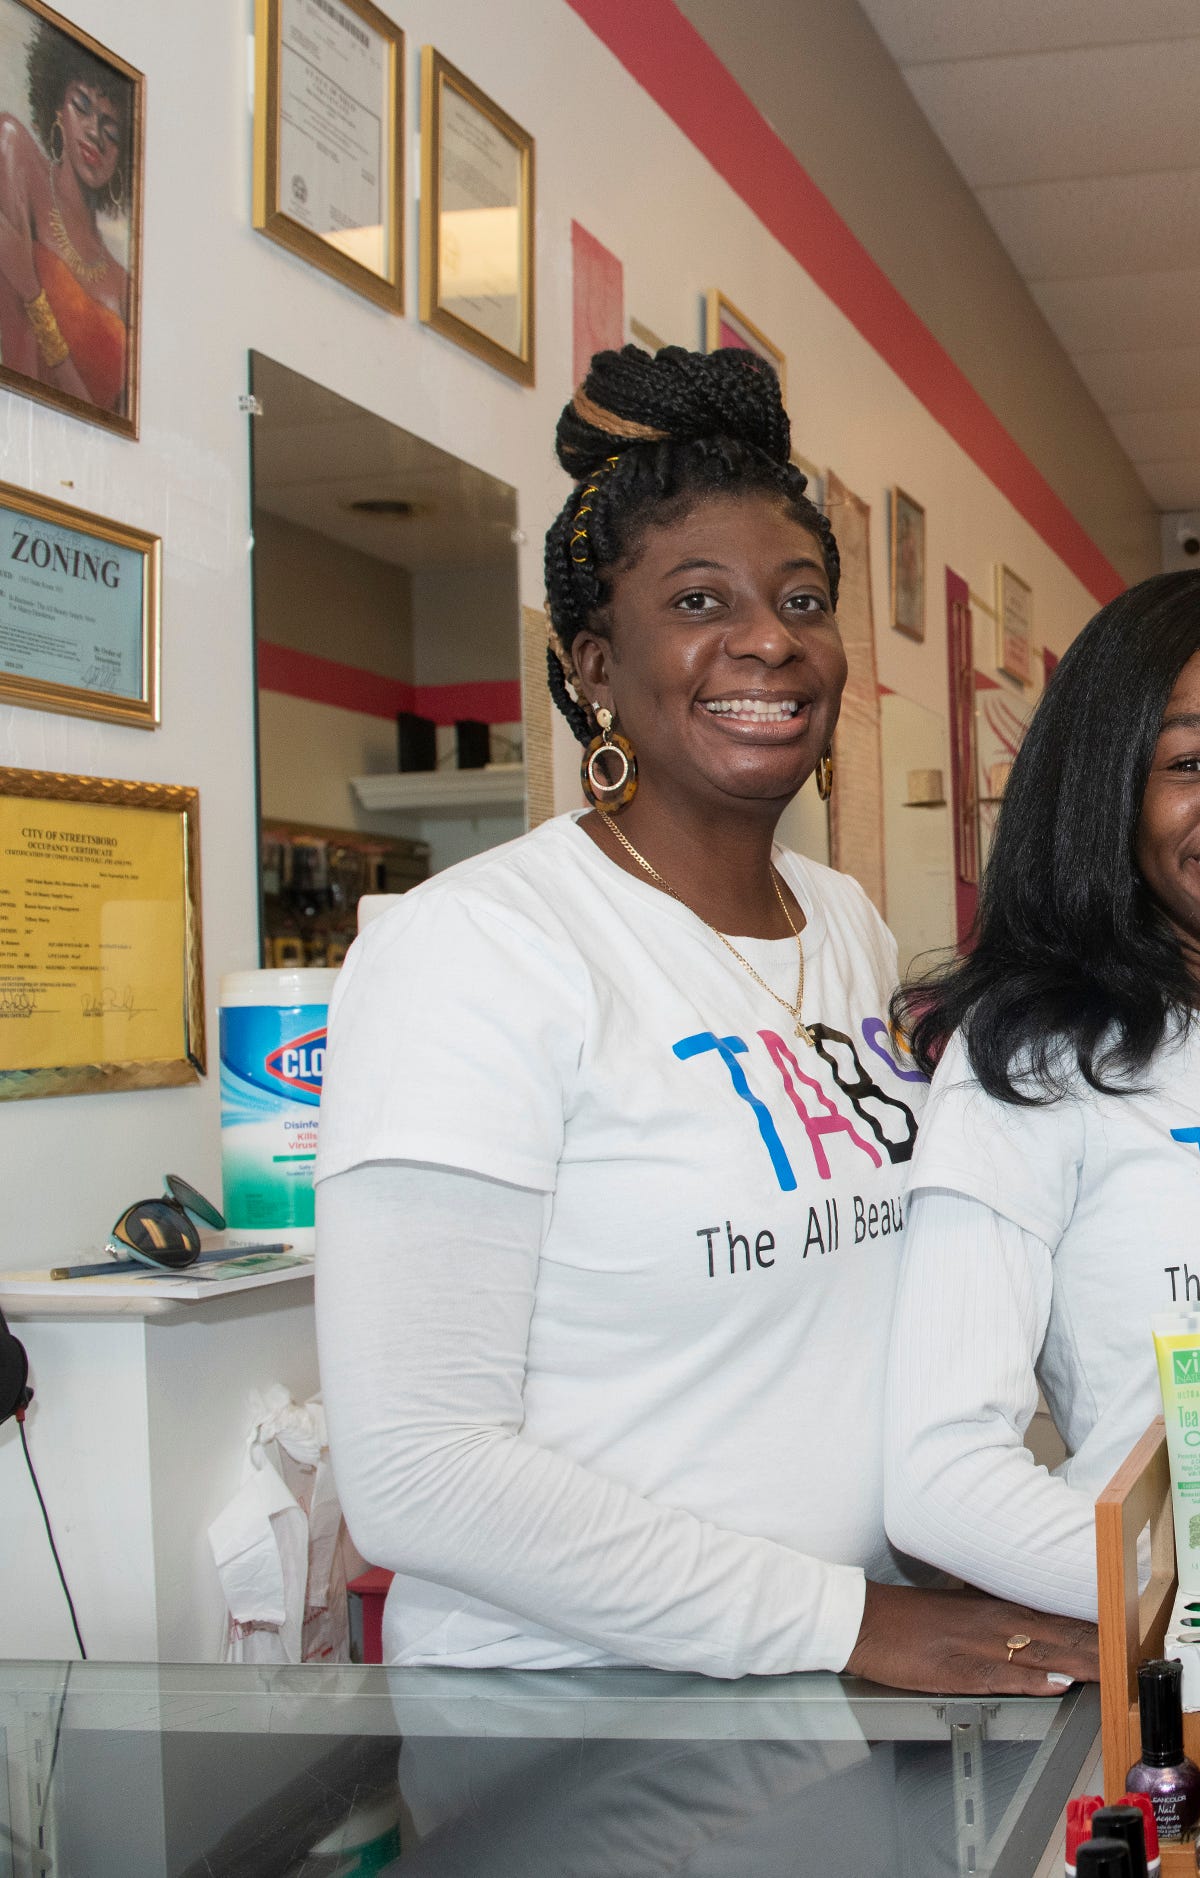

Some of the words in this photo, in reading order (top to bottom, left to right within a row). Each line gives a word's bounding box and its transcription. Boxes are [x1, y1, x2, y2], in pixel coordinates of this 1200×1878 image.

[11, 531, 120, 589] ZONING
[22, 828, 43, 840] CITY
[45, 830, 58, 841] OF
[60, 832, 118, 847] STREETSBORO
[28, 842, 69, 853] OCCUPANCY
[71, 846, 113, 857] CERTIFICATE
[696, 1220, 776, 1278] The
[803, 1198, 839, 1259] All
[1178, 1406, 1198, 1428] Tea
[1158, 1803, 1176, 1814] Nail
